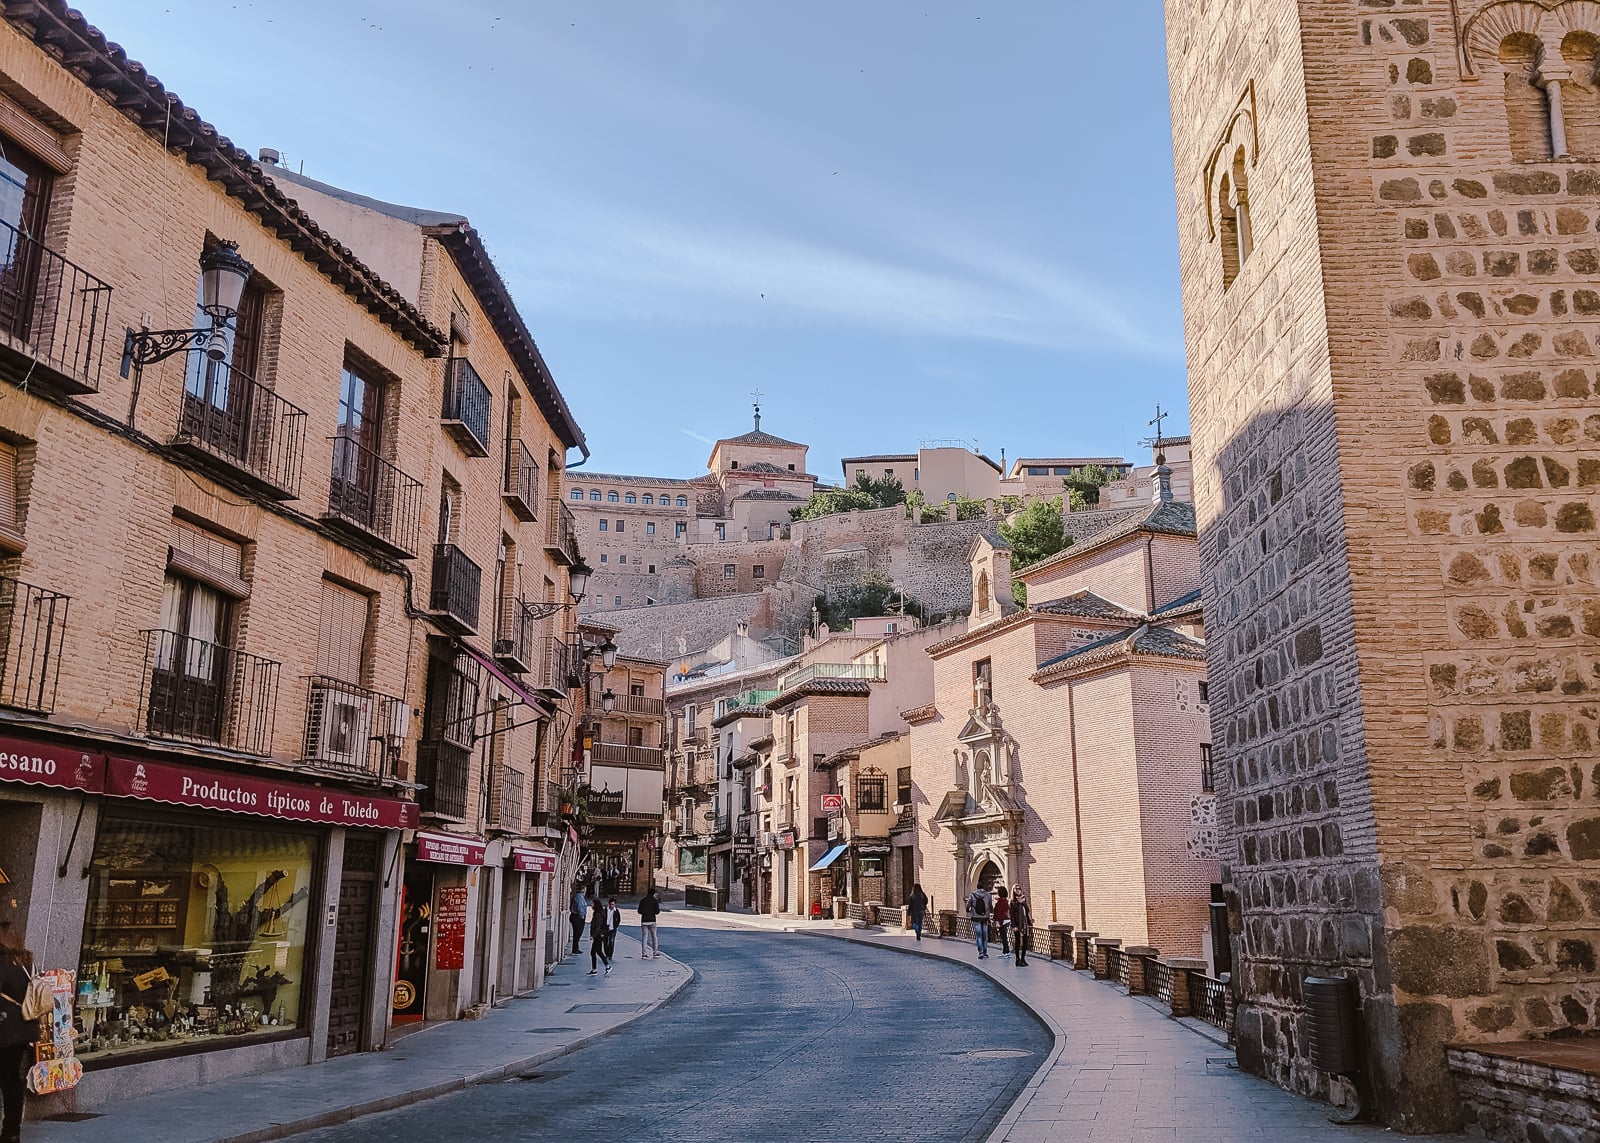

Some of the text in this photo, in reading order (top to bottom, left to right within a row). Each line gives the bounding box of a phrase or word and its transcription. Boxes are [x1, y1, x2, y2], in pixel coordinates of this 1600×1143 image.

[0, 752, 56, 775] esano
[181, 776, 379, 819] Productos típicos de Toledo
